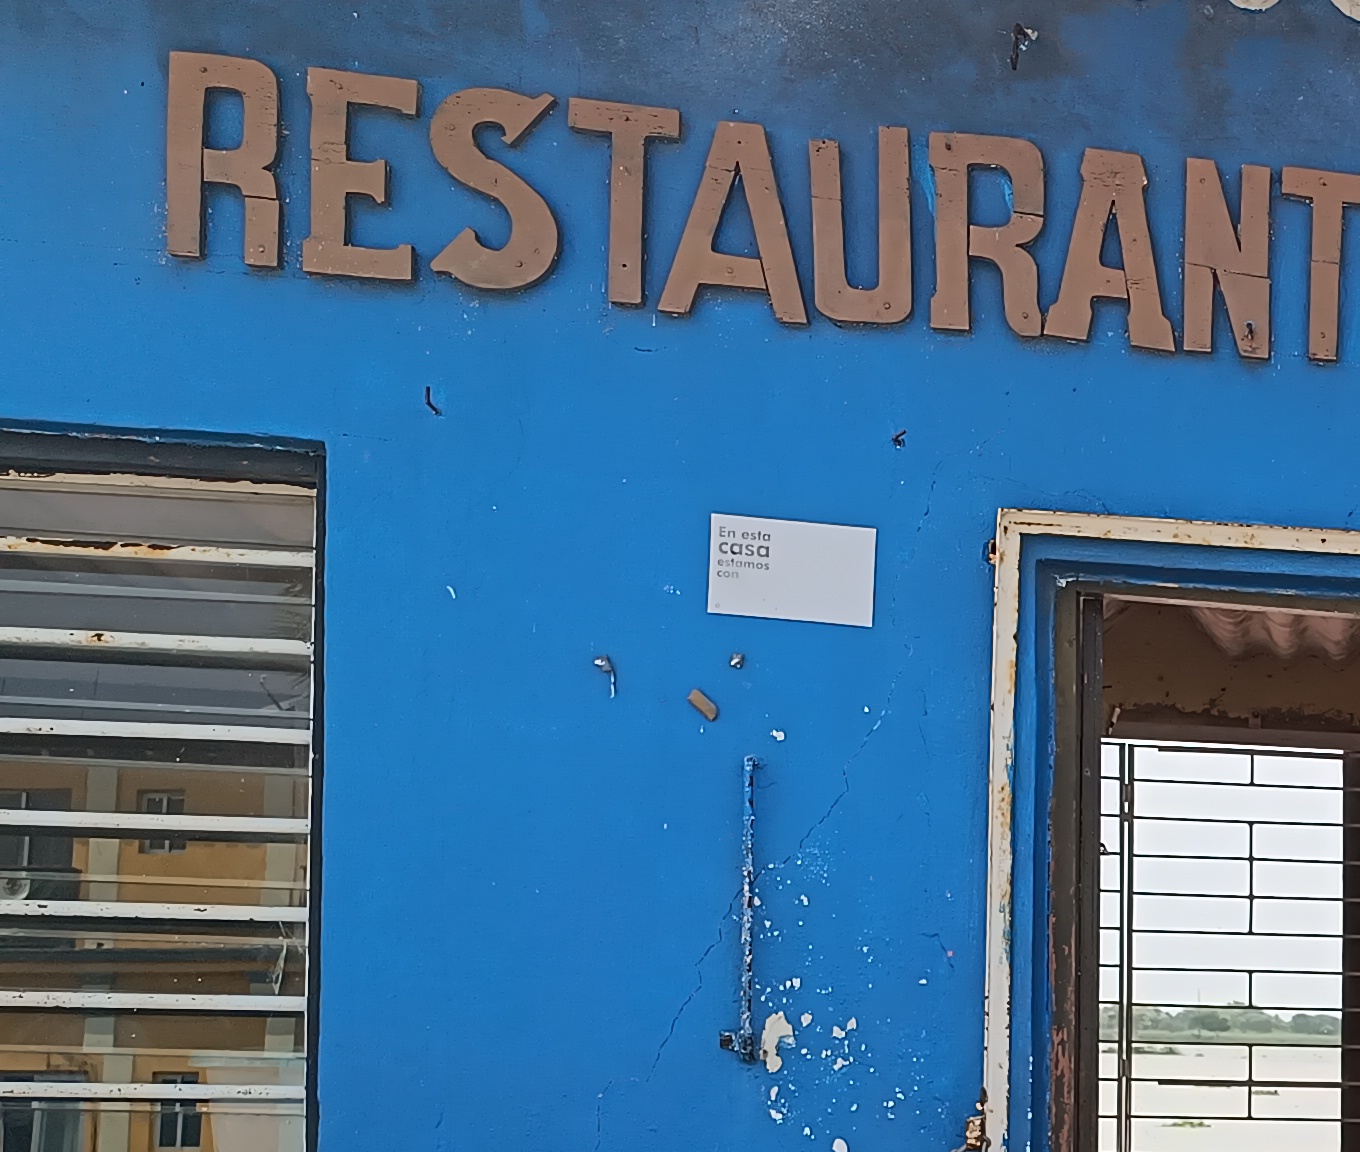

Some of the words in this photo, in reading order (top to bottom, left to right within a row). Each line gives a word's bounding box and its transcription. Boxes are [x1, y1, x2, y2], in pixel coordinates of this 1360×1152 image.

[719, 526, 736, 538] En
[741, 530, 771, 542] esta
[718, 541, 770, 558] casa
[717, 558, 770, 570] estamos
[716, 570, 739, 579] con
